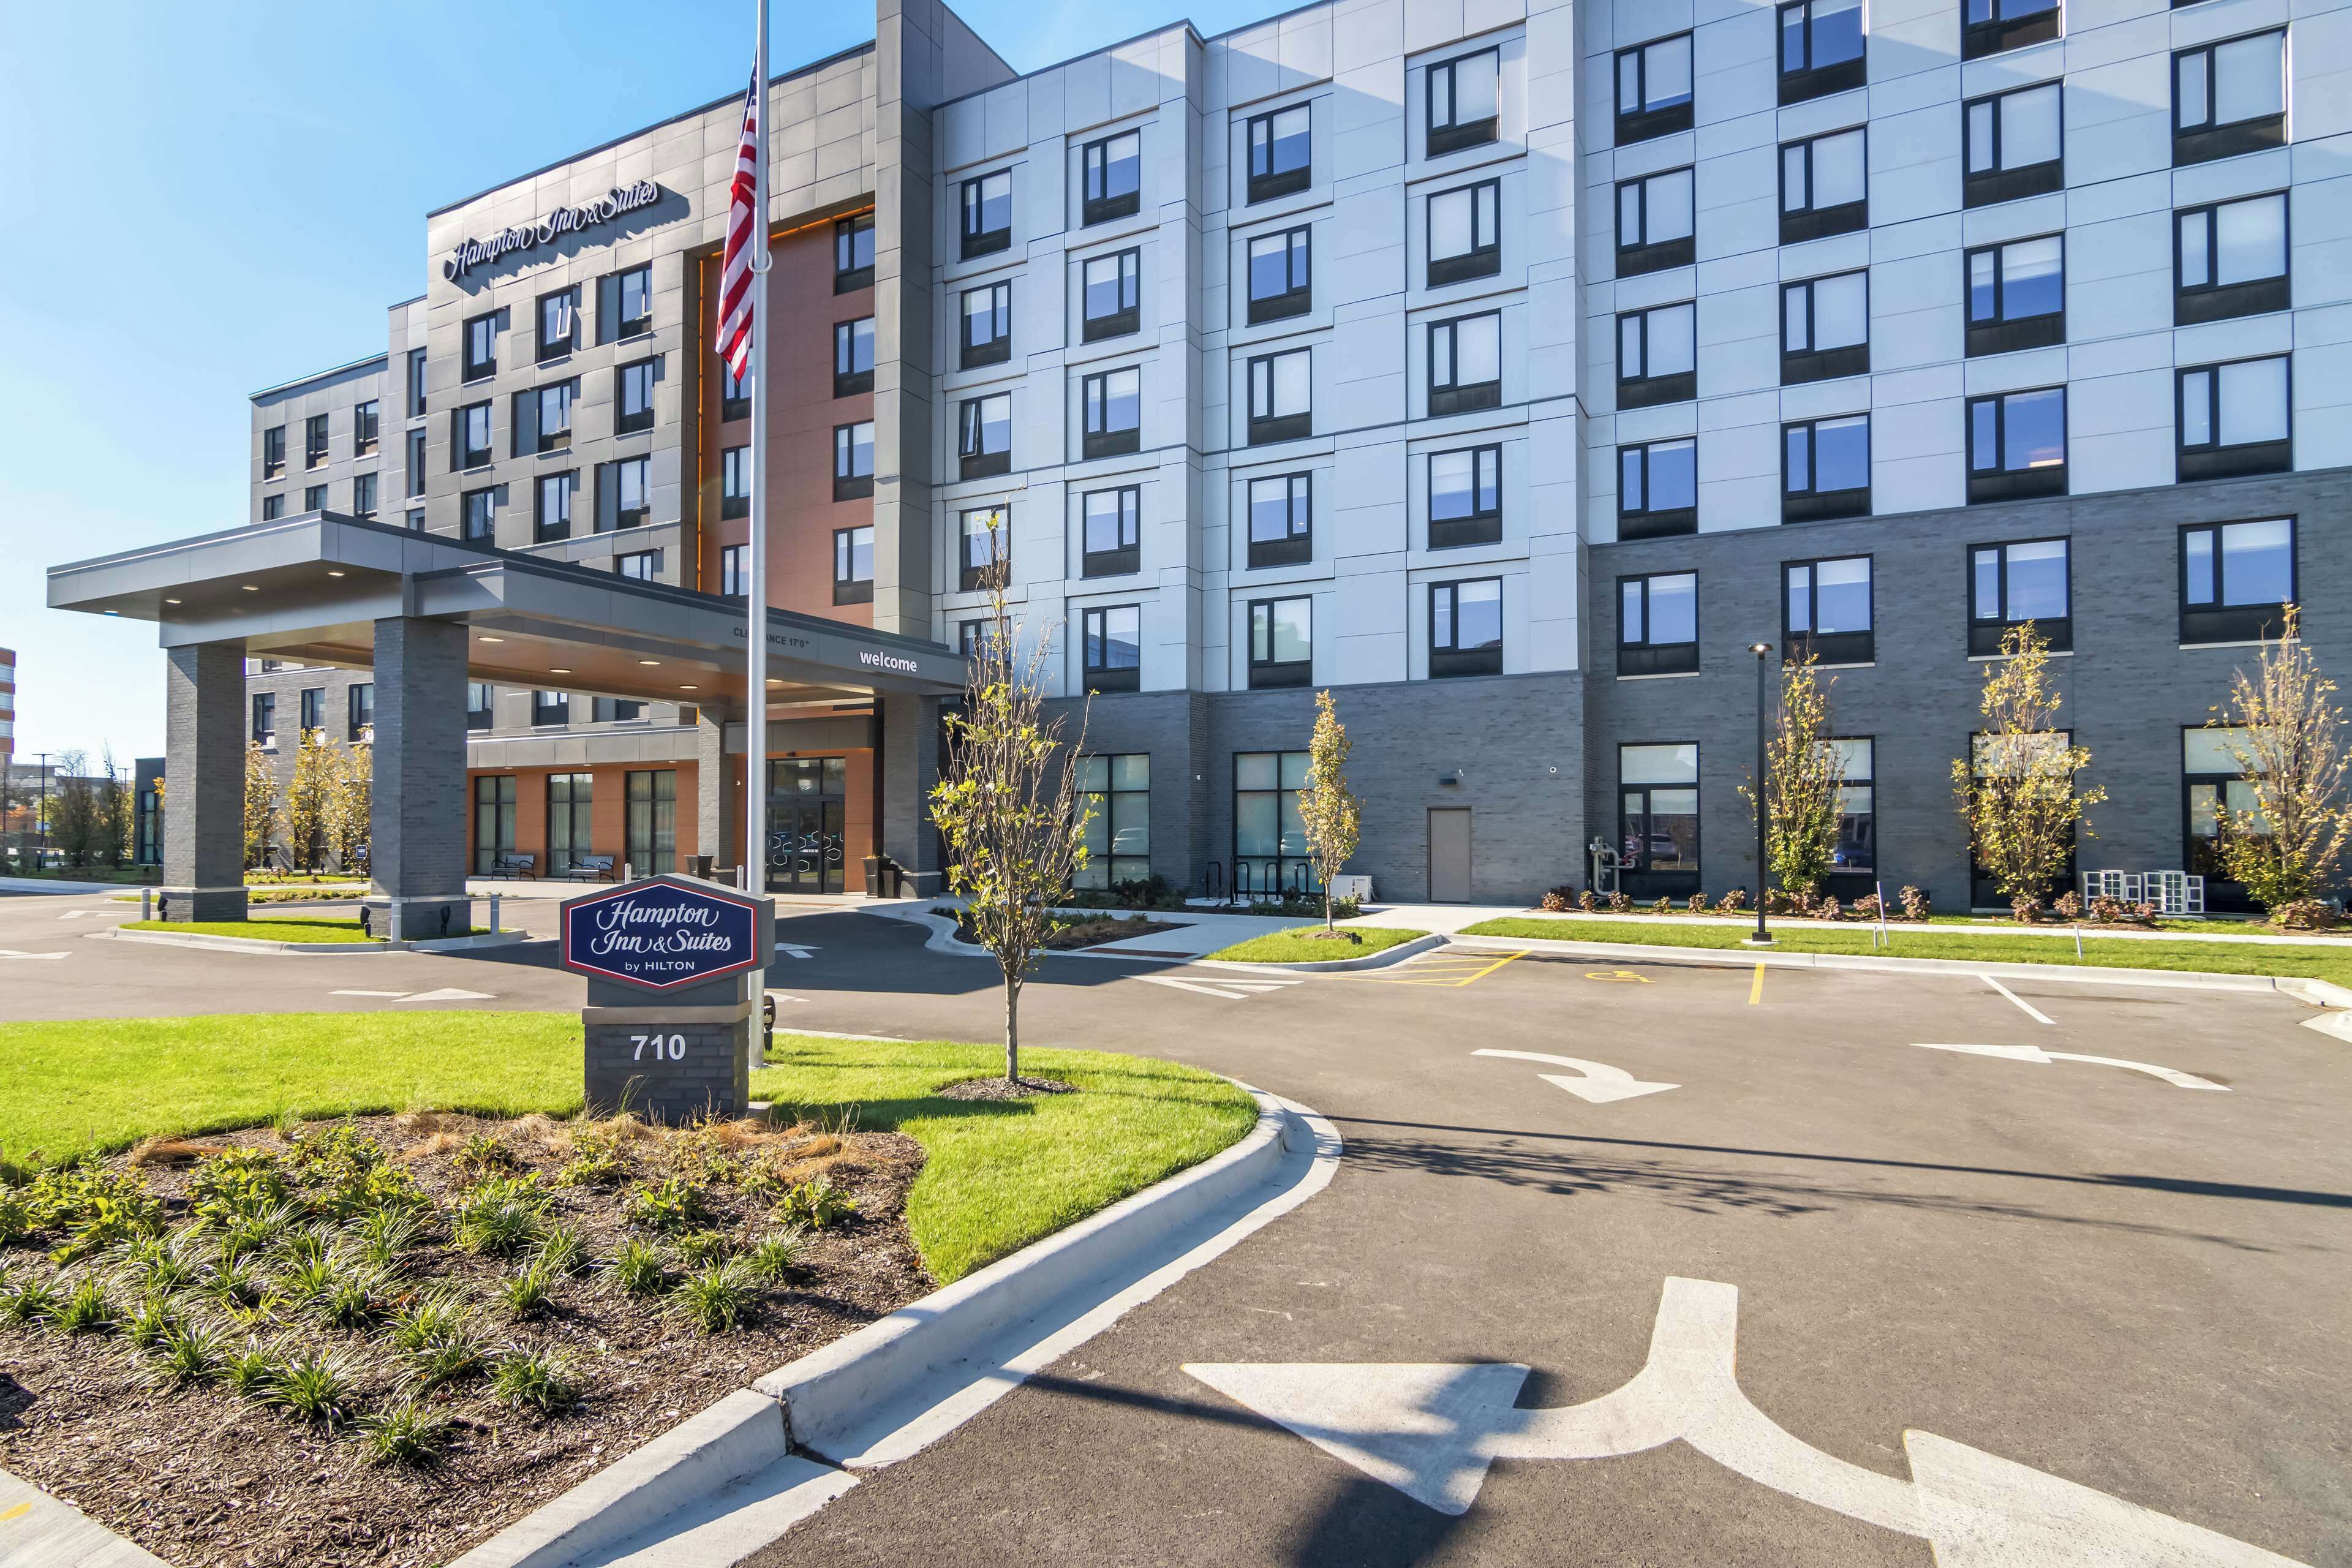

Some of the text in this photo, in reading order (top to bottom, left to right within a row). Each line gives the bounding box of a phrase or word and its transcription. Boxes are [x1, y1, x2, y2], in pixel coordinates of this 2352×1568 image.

[442, 179, 658, 282] Hampton Inn & Suites
[859, 651, 918, 673] welcome
[596, 900, 719, 930] Hampton
[591, 929, 731, 955] Inn & Suites
[625, 961, 695, 972] by HILTON
[630, 1034, 687, 1061] 710
